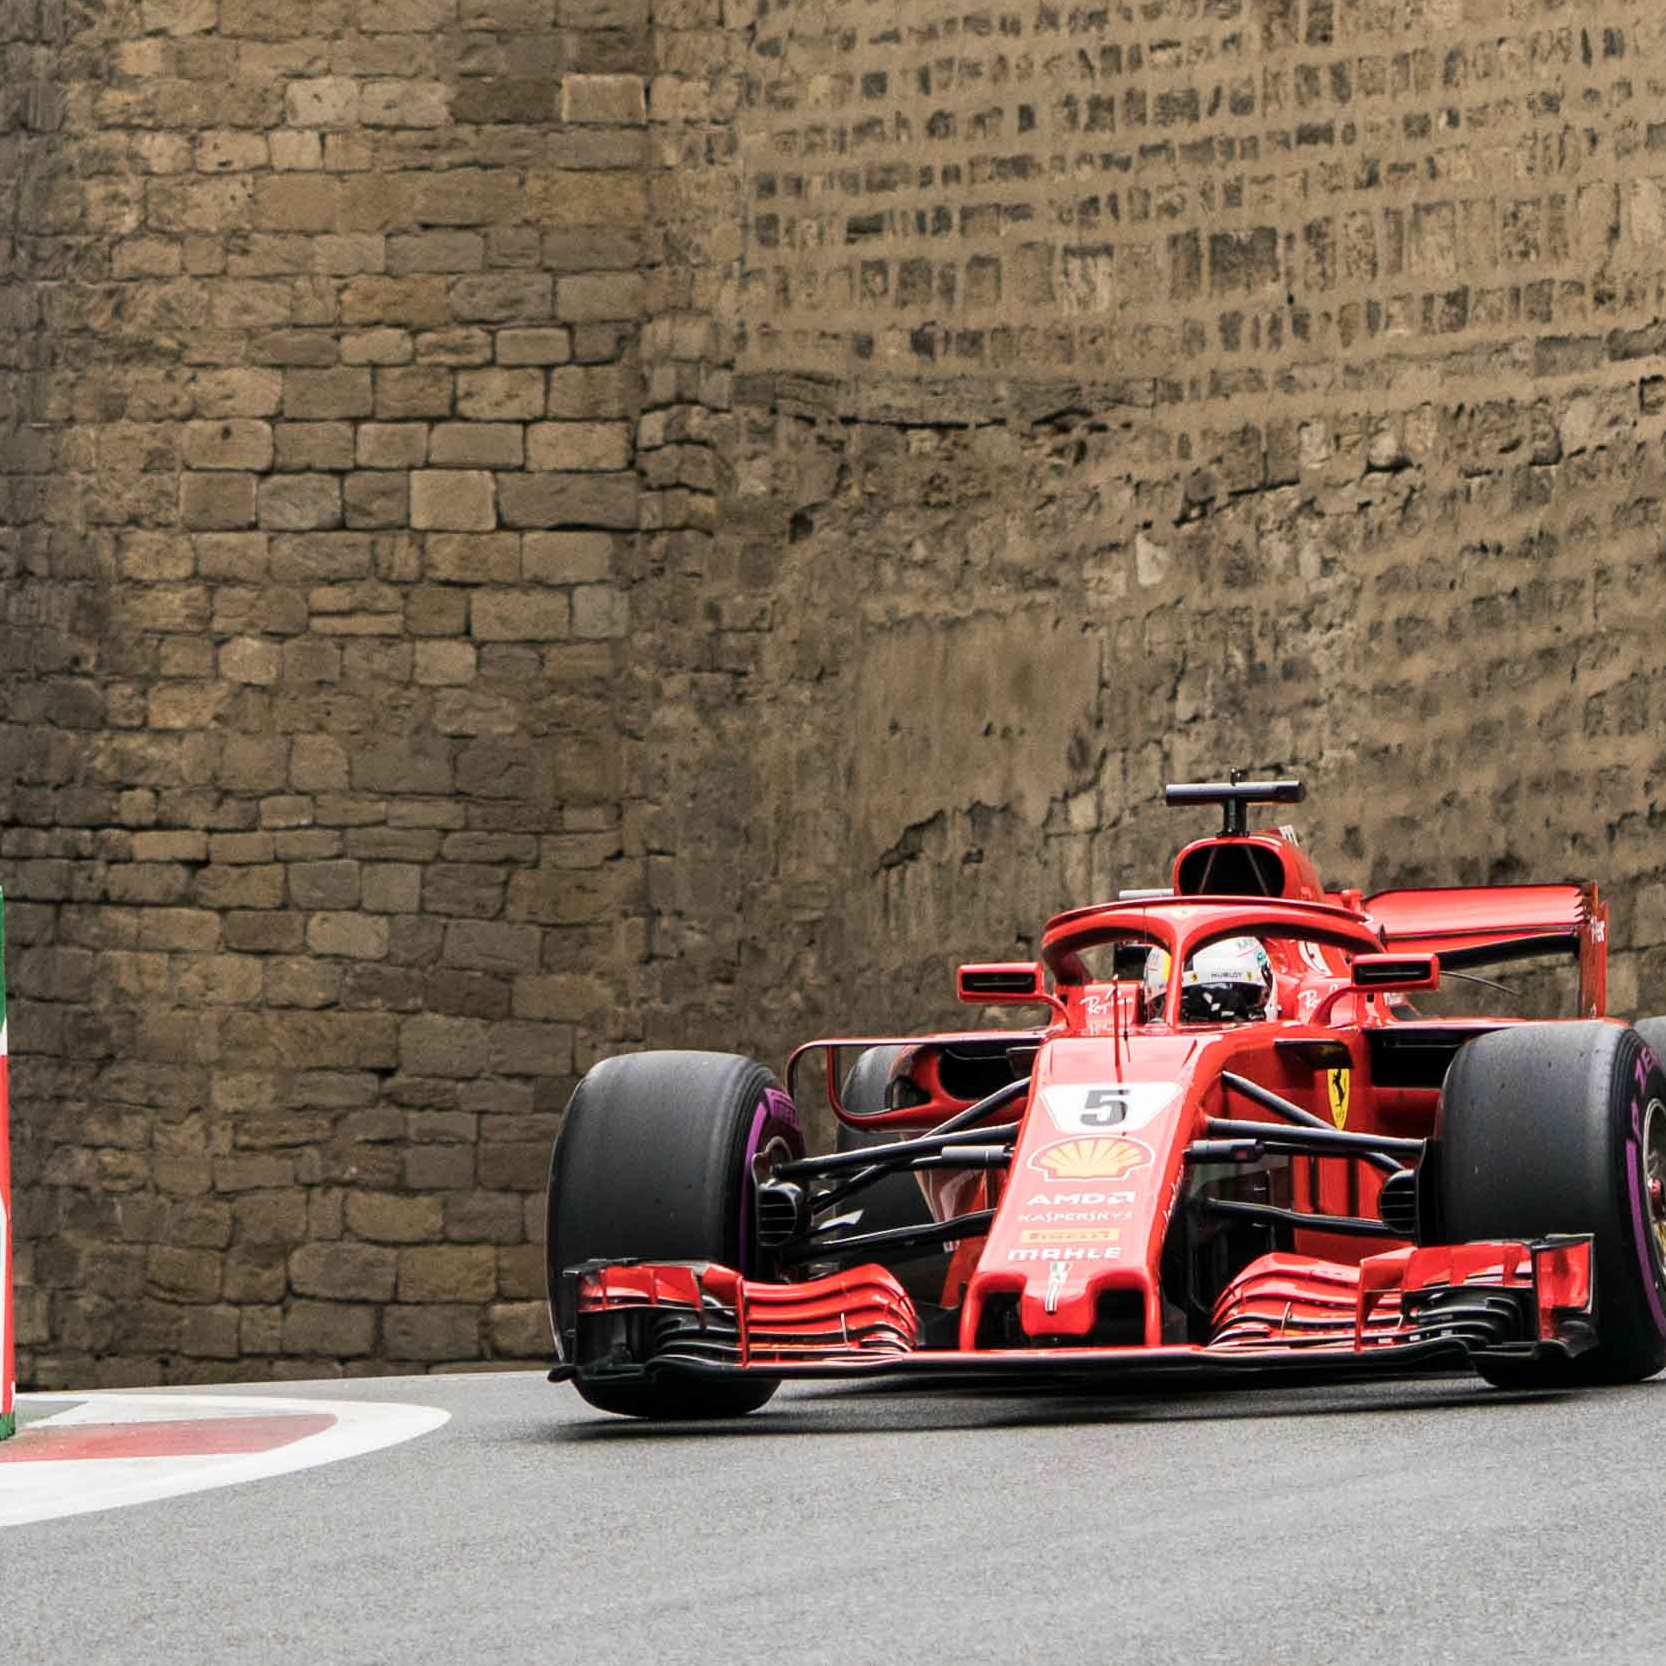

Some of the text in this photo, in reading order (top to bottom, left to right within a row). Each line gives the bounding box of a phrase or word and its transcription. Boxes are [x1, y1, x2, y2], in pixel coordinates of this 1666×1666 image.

[1080, 1089, 1130, 1127] 5
[1026, 1191, 1106, 1206] AMD
[1006, 1246, 1123, 1262] MAHLE
